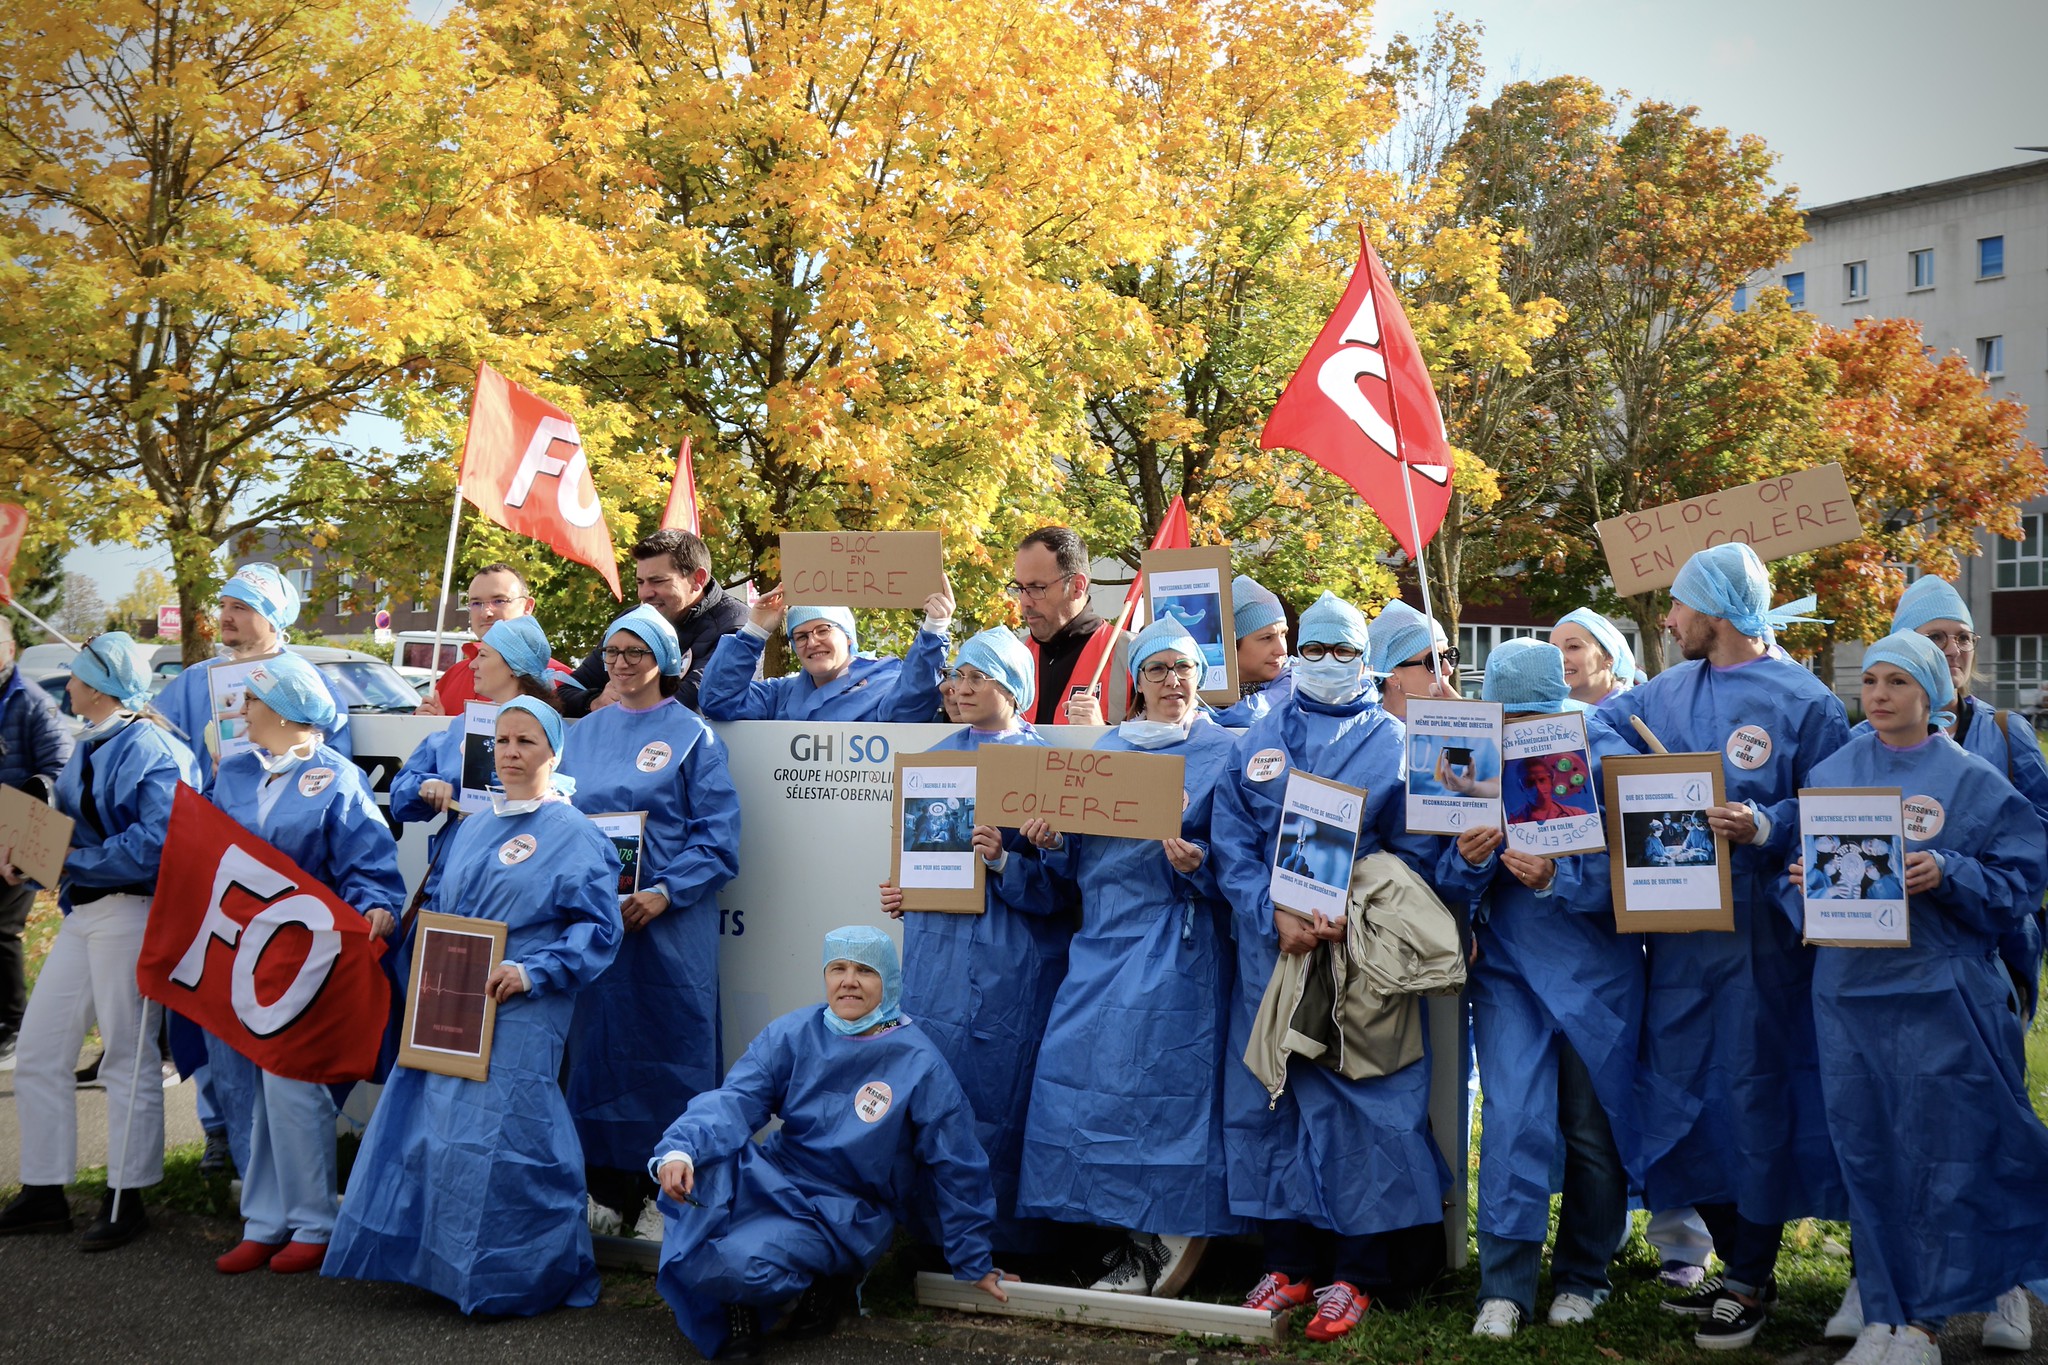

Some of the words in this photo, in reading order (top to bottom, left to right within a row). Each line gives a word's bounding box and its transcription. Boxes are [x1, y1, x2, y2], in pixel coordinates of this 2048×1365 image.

[1624, 498, 1722, 543] BLOC
[1758, 477, 1794, 503] OP
[830, 535, 880, 553] BLOC
[850, 555, 865, 566] EN
[1630, 544, 1675, 578] EN
[793, 570, 908, 595] COLERE
[1193, 582, 1211, 590] CONSTANT
[1453, 720, 1468, 728] MÊME
[1514, 727, 1533, 740] EN
[1737, 731, 1768, 749] PERSONNEL
[1744, 744, 1753, 752] EN
[1046, 750, 1113, 777] BLOC
[1254, 756, 1282, 764] PERSONNEL
[774, 768, 821, 782] GROUPE
[1064, 774, 1086, 788] EN
[786, 784, 893, 802] SÉLESTAT-OBERNAI
[1001, 791, 1139, 823] COLERE
[1422, 799, 1462, 807] RECONNAISSANCE
[1904, 803, 1940, 818] PERSONNEL
[1292, 800, 1310, 813] TOUJOURS
[1309, 807, 1319, 816] PLUS
[1319, 810, 1325, 818] DE
[1325, 811, 1343, 823] MISSIONS
[1915, 815, 1924, 824] EN
[1279, 873, 1294, 883] JAMAIS
[1294, 878, 1303, 887] PLUS
[1303, 881, 1308, 889] DE
[1632, 878, 1650, 886] JAMAIS
[168, 842, 342, 1040] FO
[866, 1086, 889, 1105] PERSONNEL
[871, 1099, 877, 1107] EN
